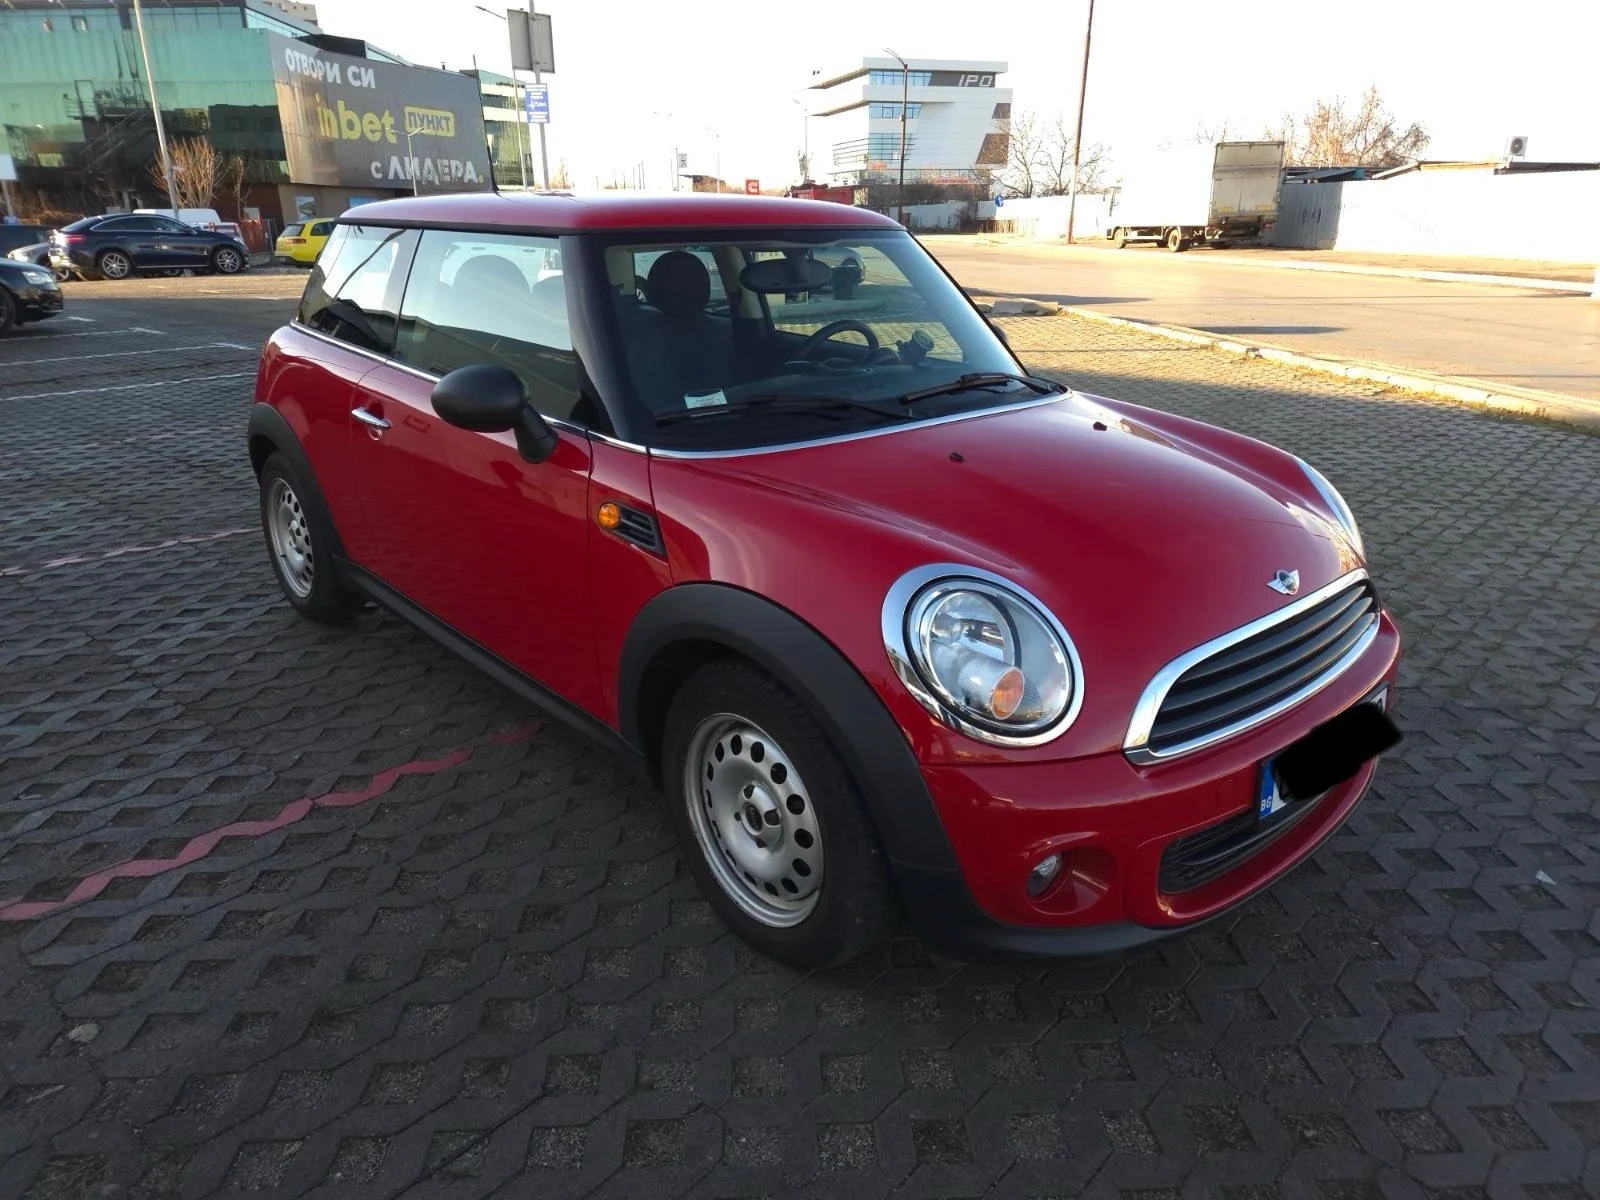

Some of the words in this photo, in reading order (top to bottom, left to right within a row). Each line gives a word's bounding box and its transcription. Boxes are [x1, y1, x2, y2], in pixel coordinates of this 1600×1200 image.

[285, 47, 342, 85] ОТВОРИ
[347, 65, 376, 89] СИ
[315, 93, 397, 144] inbet
[408, 111, 451, 133] ПУНКТ
[1260, 795, 1273, 812] BG
